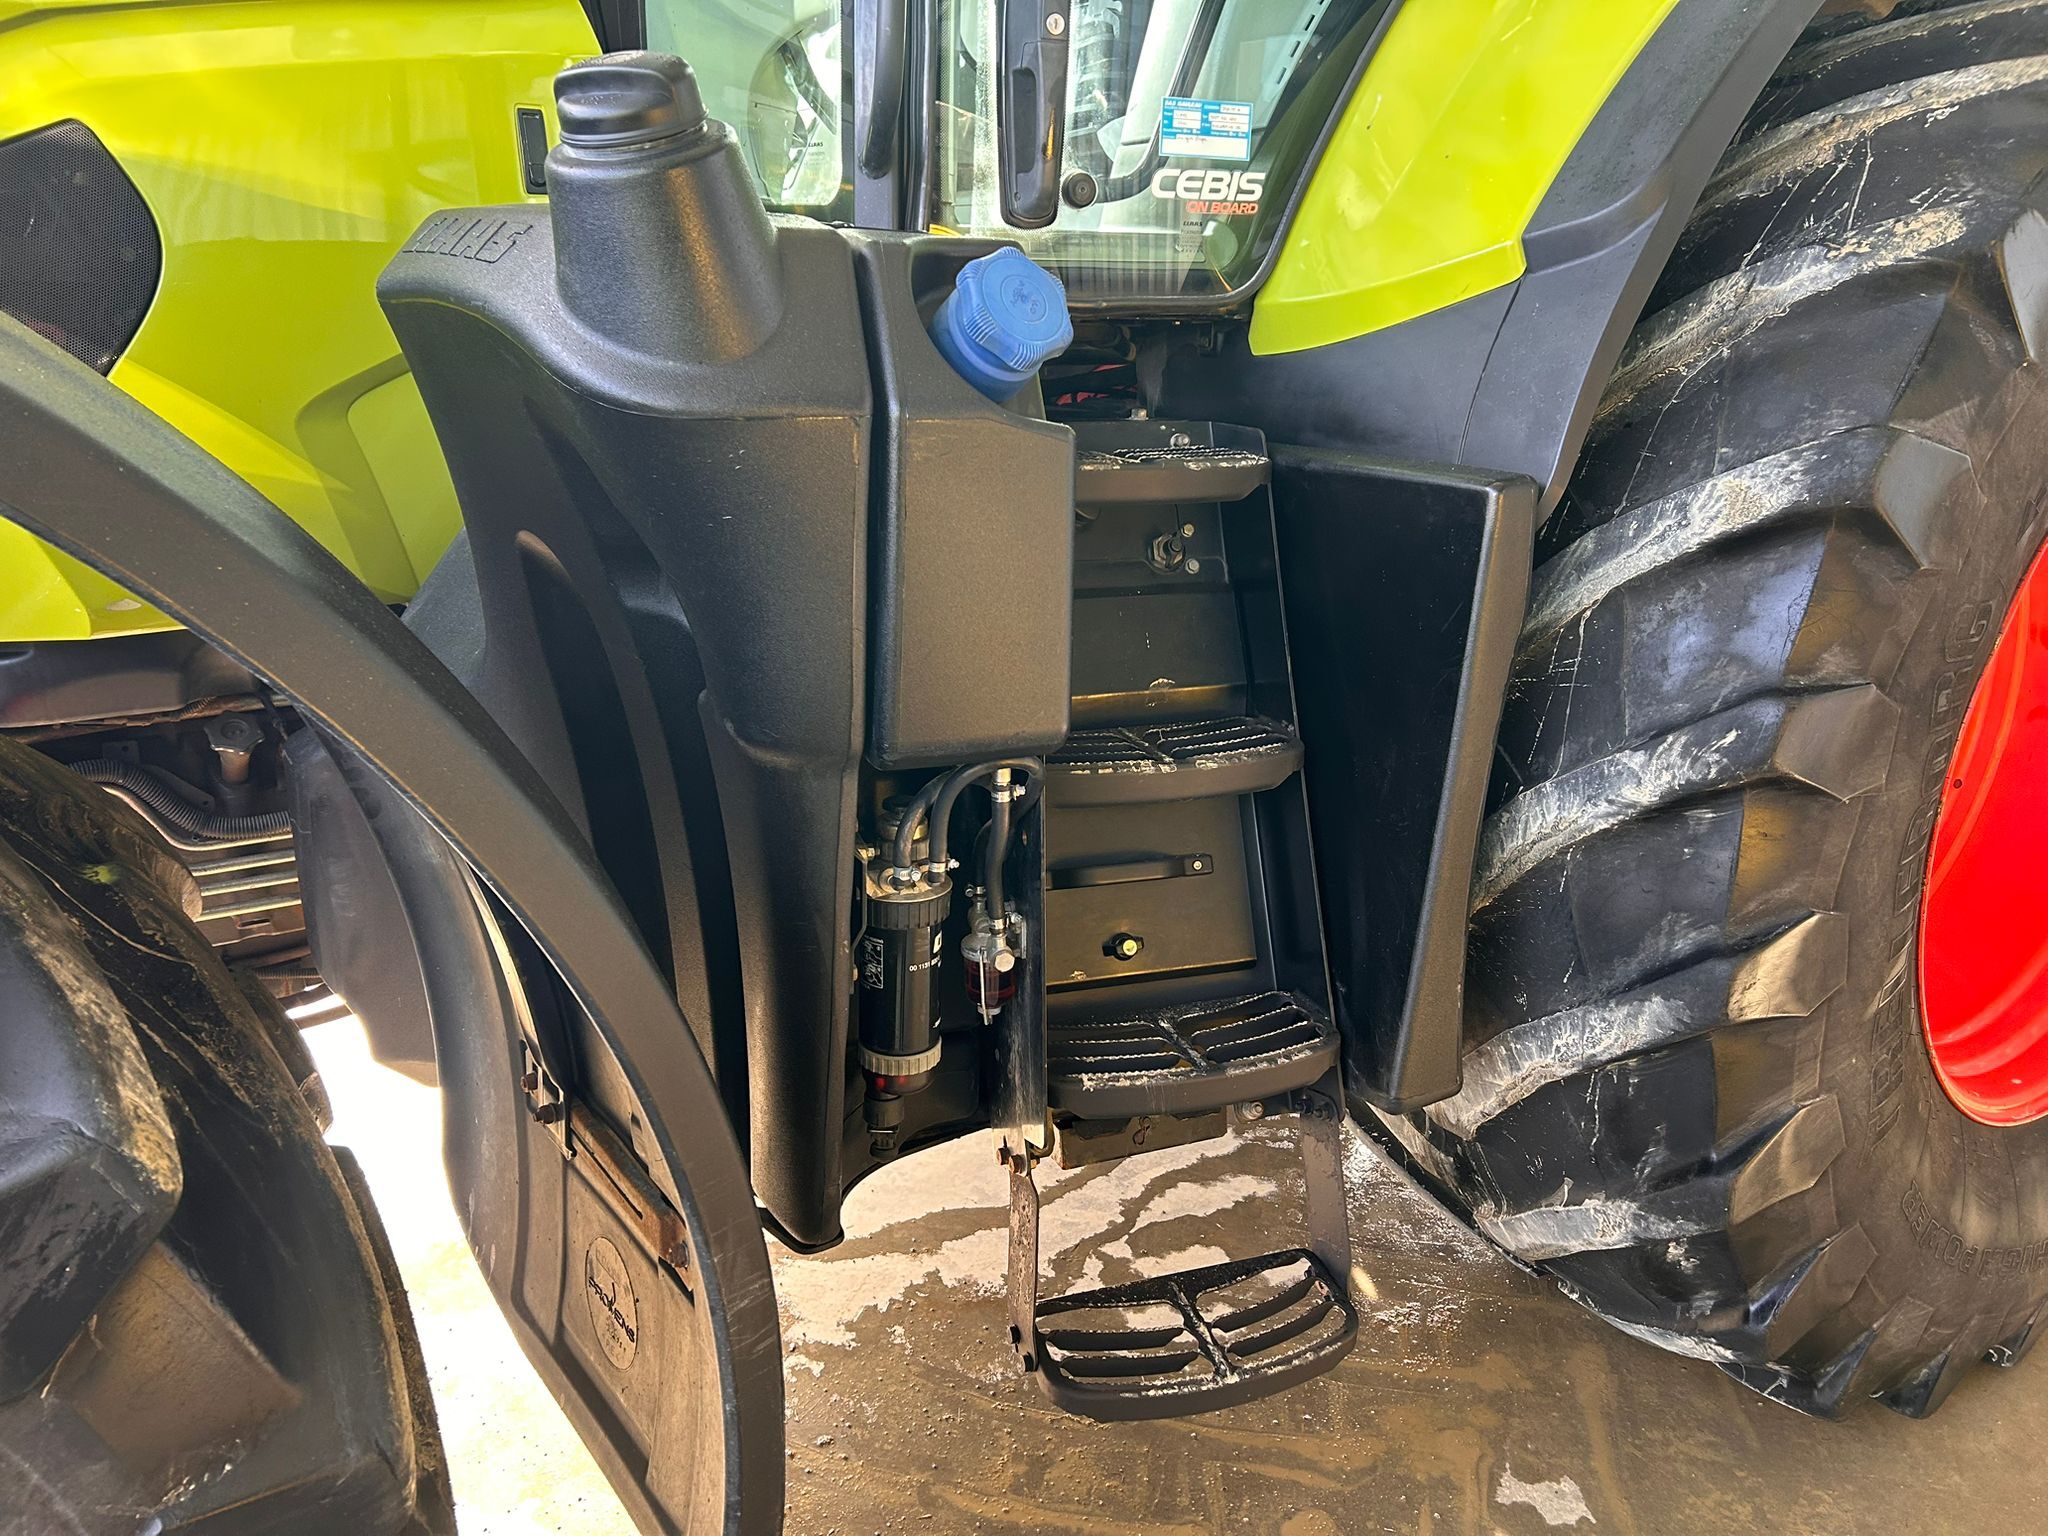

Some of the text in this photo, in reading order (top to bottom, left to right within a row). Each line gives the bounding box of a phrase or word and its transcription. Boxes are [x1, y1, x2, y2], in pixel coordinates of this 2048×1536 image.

[1151, 168, 1266, 202] CEBIS
[1186, 200, 1259, 215] ON BOARD
